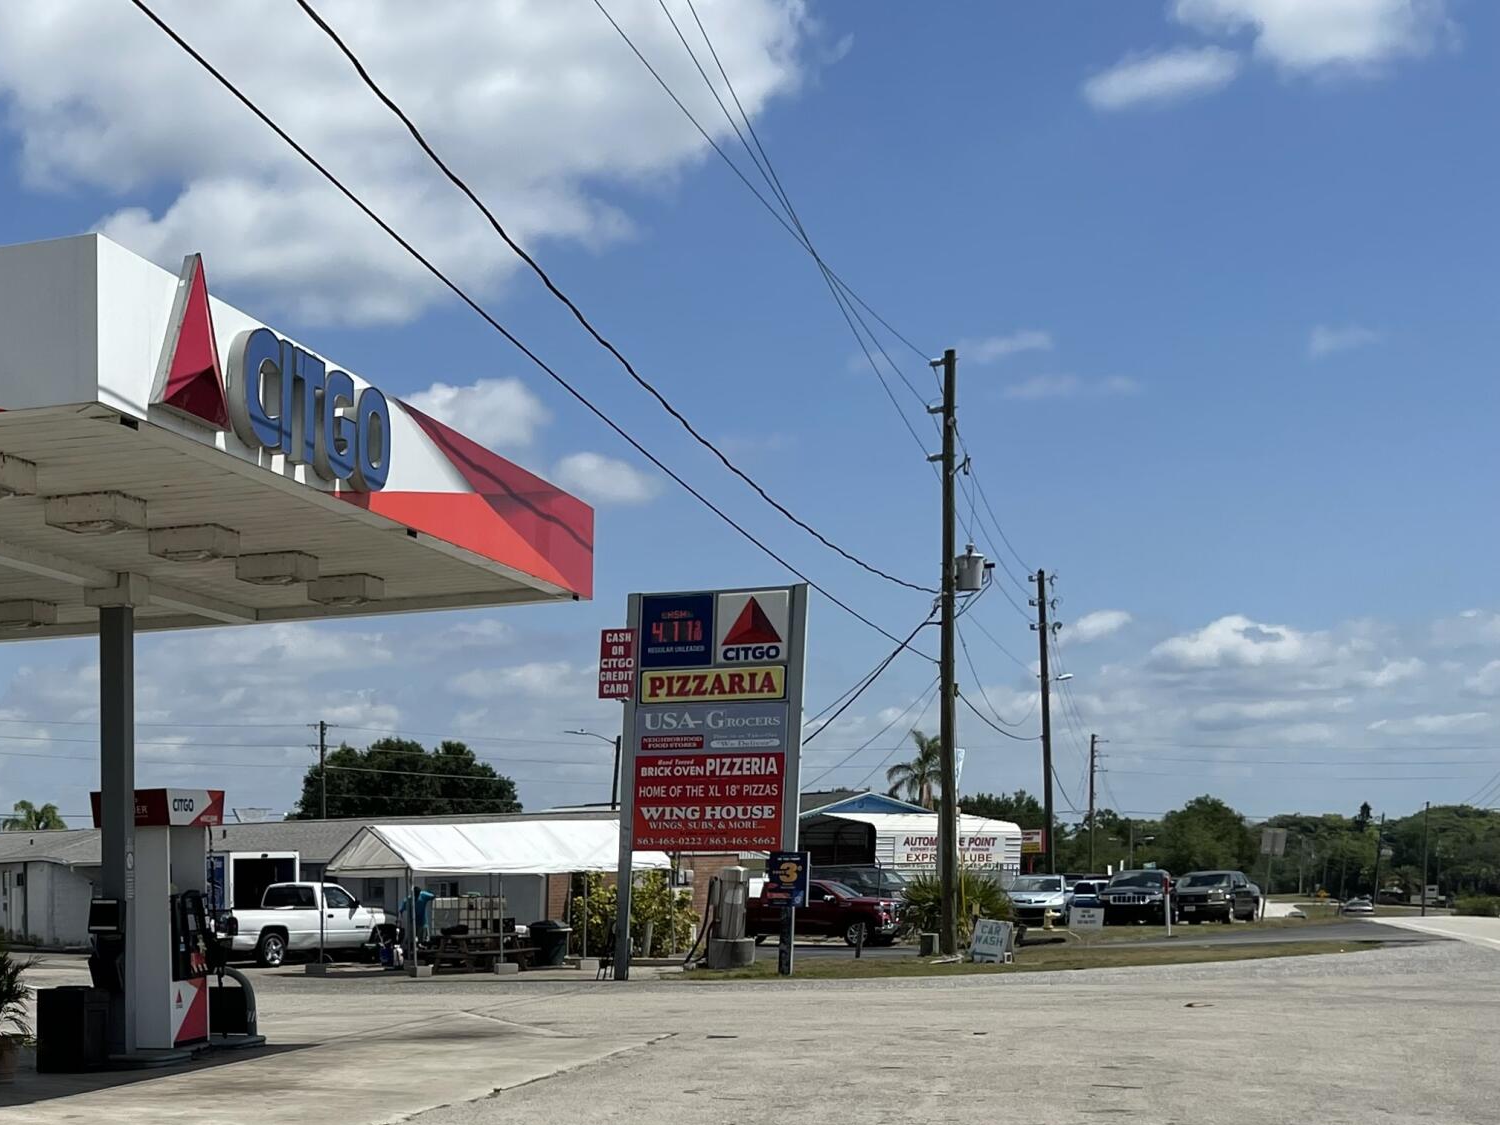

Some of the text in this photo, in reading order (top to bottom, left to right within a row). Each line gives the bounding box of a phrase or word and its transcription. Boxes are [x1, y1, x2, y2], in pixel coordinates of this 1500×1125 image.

[229, 328, 391, 492] CITGO
[606, 633, 631, 643] CASH
[611, 646, 624, 656] OR
[648, 645, 705, 654] REGULAR UNLEADED
[722, 645, 781, 661] CITGO
[601, 658, 634, 669] CITGO
[600, 671, 634, 681] CREDIT
[603, 684, 629, 694] CARD
[648, 671, 777, 699] PIZZARIA
[706, 710, 781, 729] GROCERS
[642, 735, 703, 743] NEIGHBORHOOD
[640, 757, 778, 777] BRICK OVEN PIZZERIA
[639, 786, 667, 798] HOME
[669, 785, 683, 798] OF
[685, 784, 705, 797] THE
[708, 784, 721, 797] XL
[743, 783, 778, 796] PIZZAS
[172, 798, 194, 812] CITGO
[640, 805, 776, 820] WING HOUSE
[648, 820, 686, 831] WINGS,
[687, 820, 716, 831] SUBS,
[717, 820, 726, 830] &
[636, 837, 702, 845] 863-465-0222
[709, 836, 776, 845] 863-465-5662
[968, 837, 997, 847] POINT
[962, 853, 993, 863] LUBE
[980, 925, 1001, 936] CAR
[975, 934, 1004, 947] WASH
